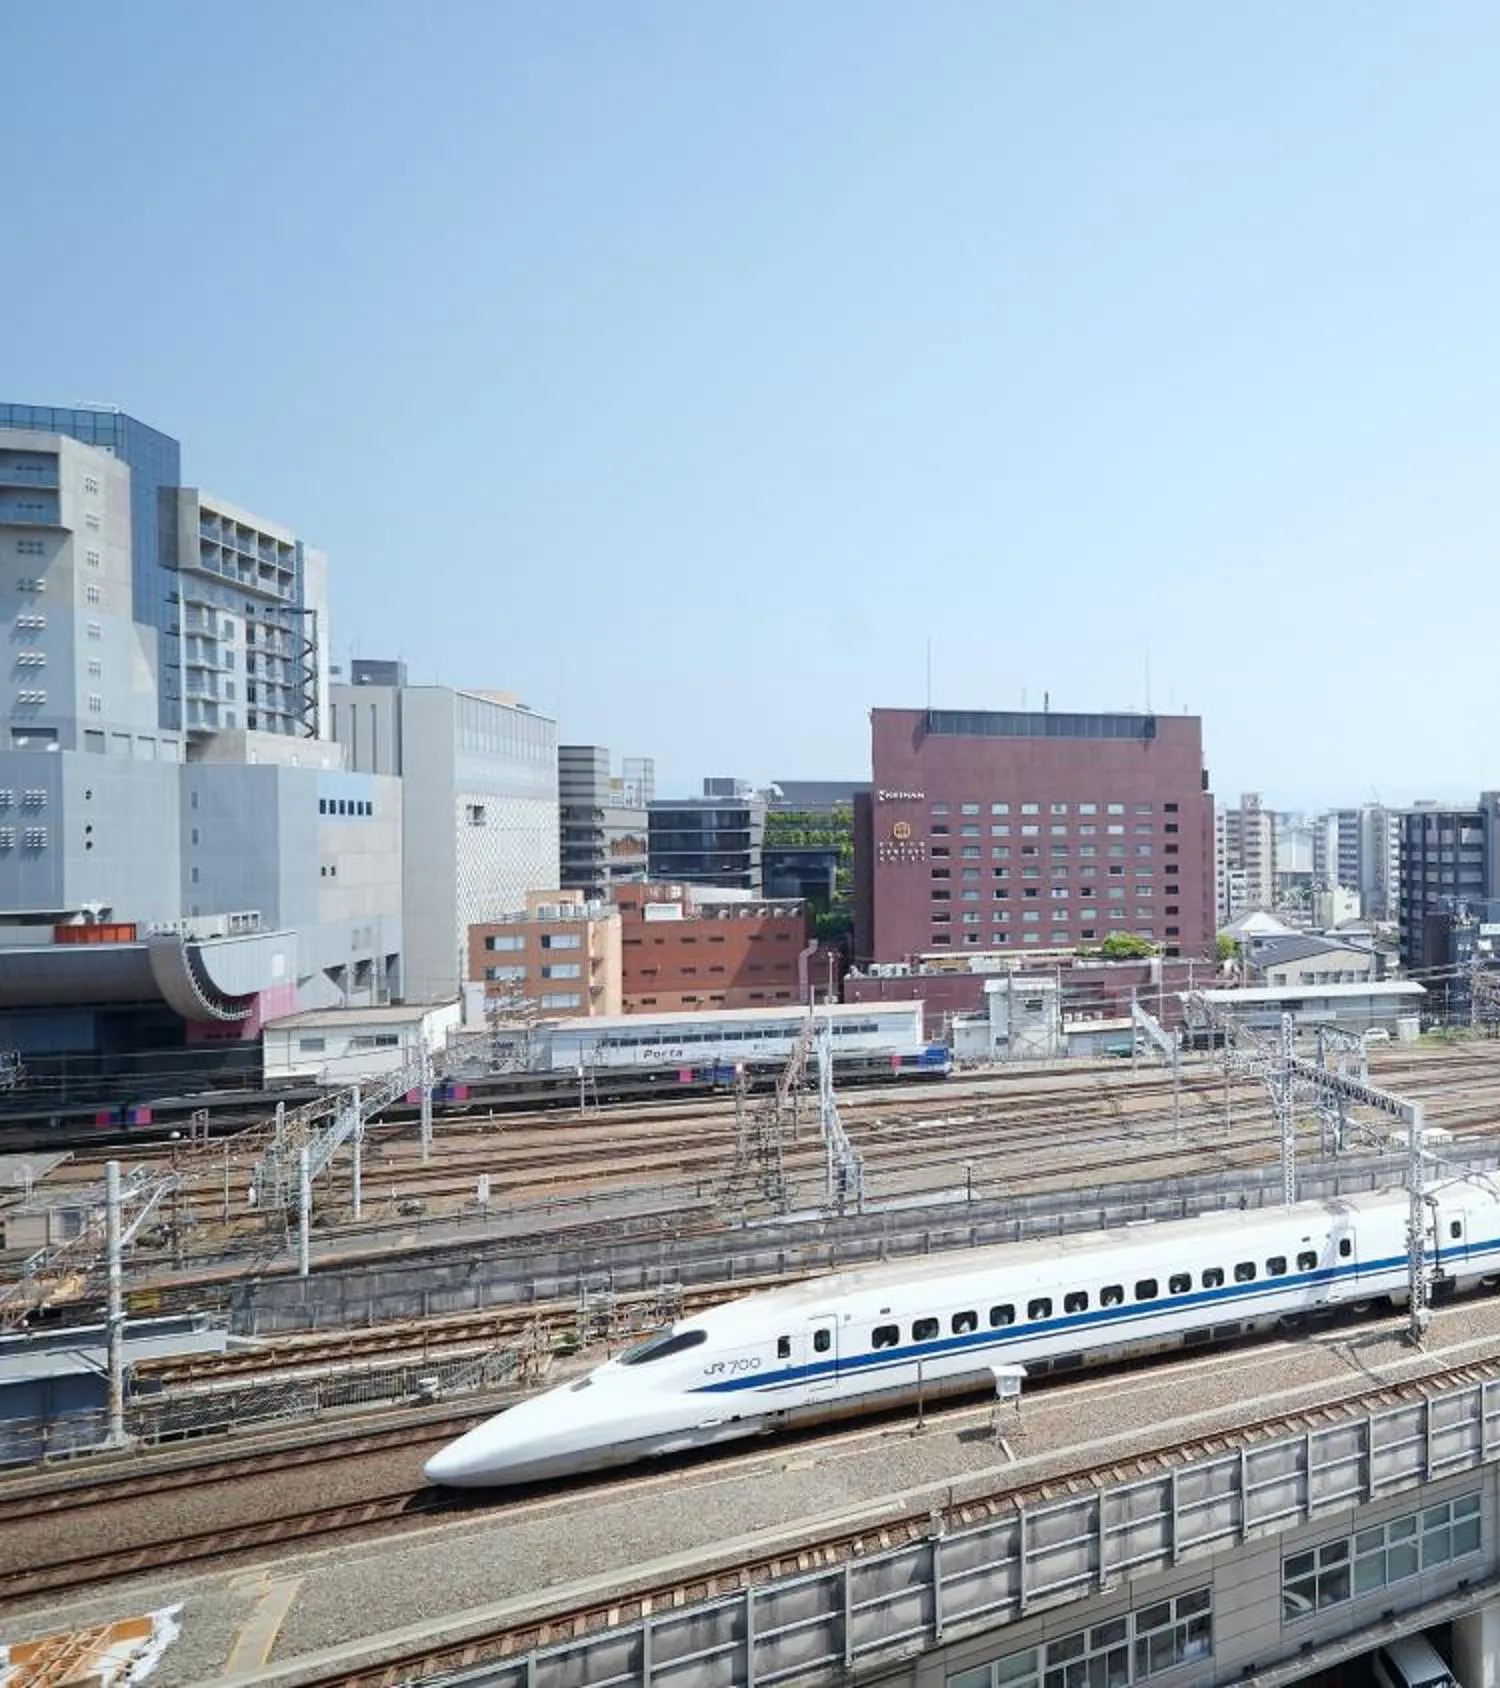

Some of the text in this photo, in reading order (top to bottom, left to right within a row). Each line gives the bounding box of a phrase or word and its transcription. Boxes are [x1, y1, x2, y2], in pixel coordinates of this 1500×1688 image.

[643, 1048, 684, 1060] Porta
[703, 1357, 761, 1375] JR 700
